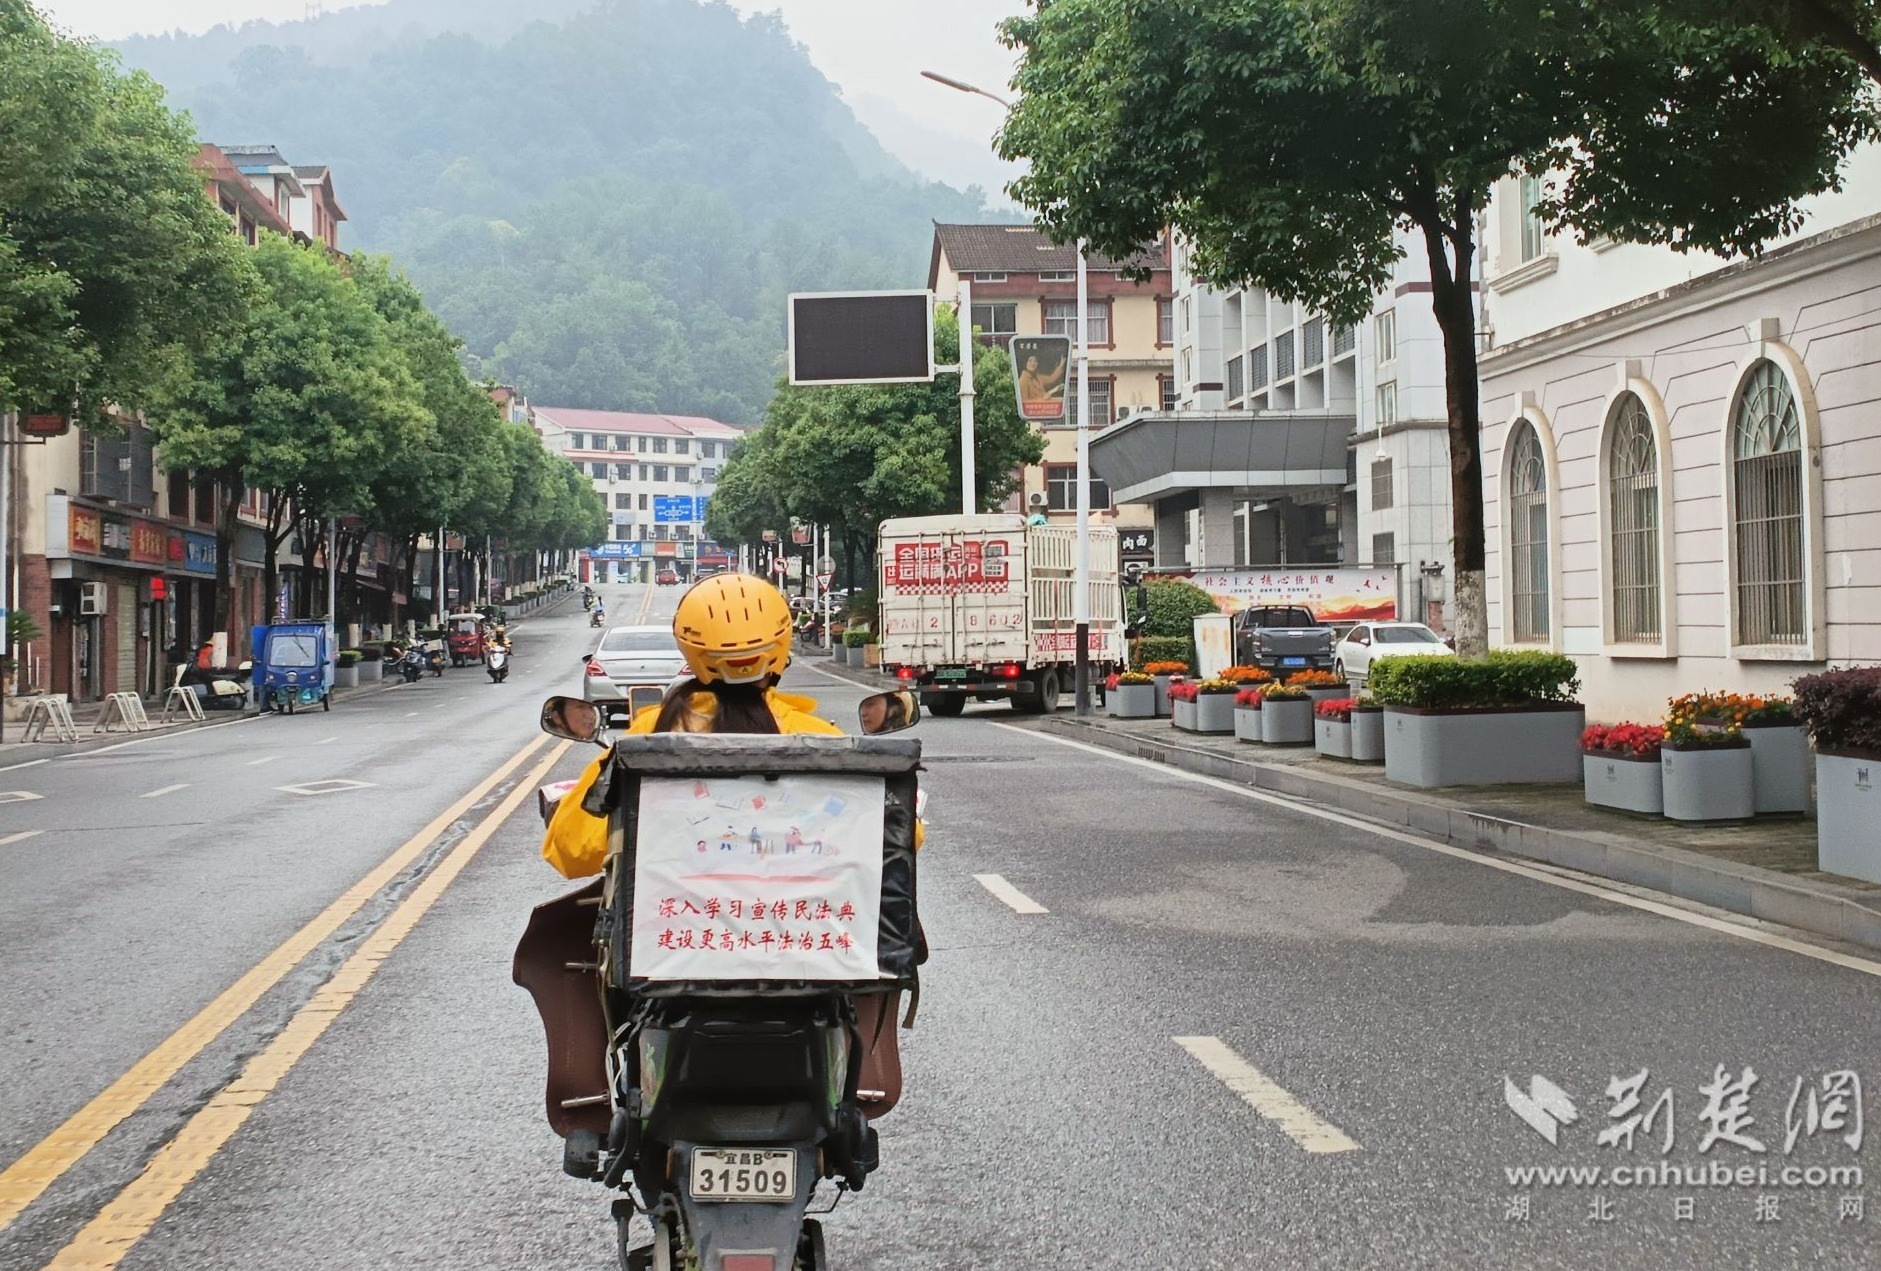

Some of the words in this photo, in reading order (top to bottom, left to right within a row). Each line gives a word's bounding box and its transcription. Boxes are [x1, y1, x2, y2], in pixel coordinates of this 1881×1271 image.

[1205, 574, 1334, 586] 社会主义核心价值观
[658, 898, 856, 921] 深入学习宣传民法典
[657, 928, 855, 955] 建设更高水平法治五峰
[699, 1169, 787, 1195] 31509
